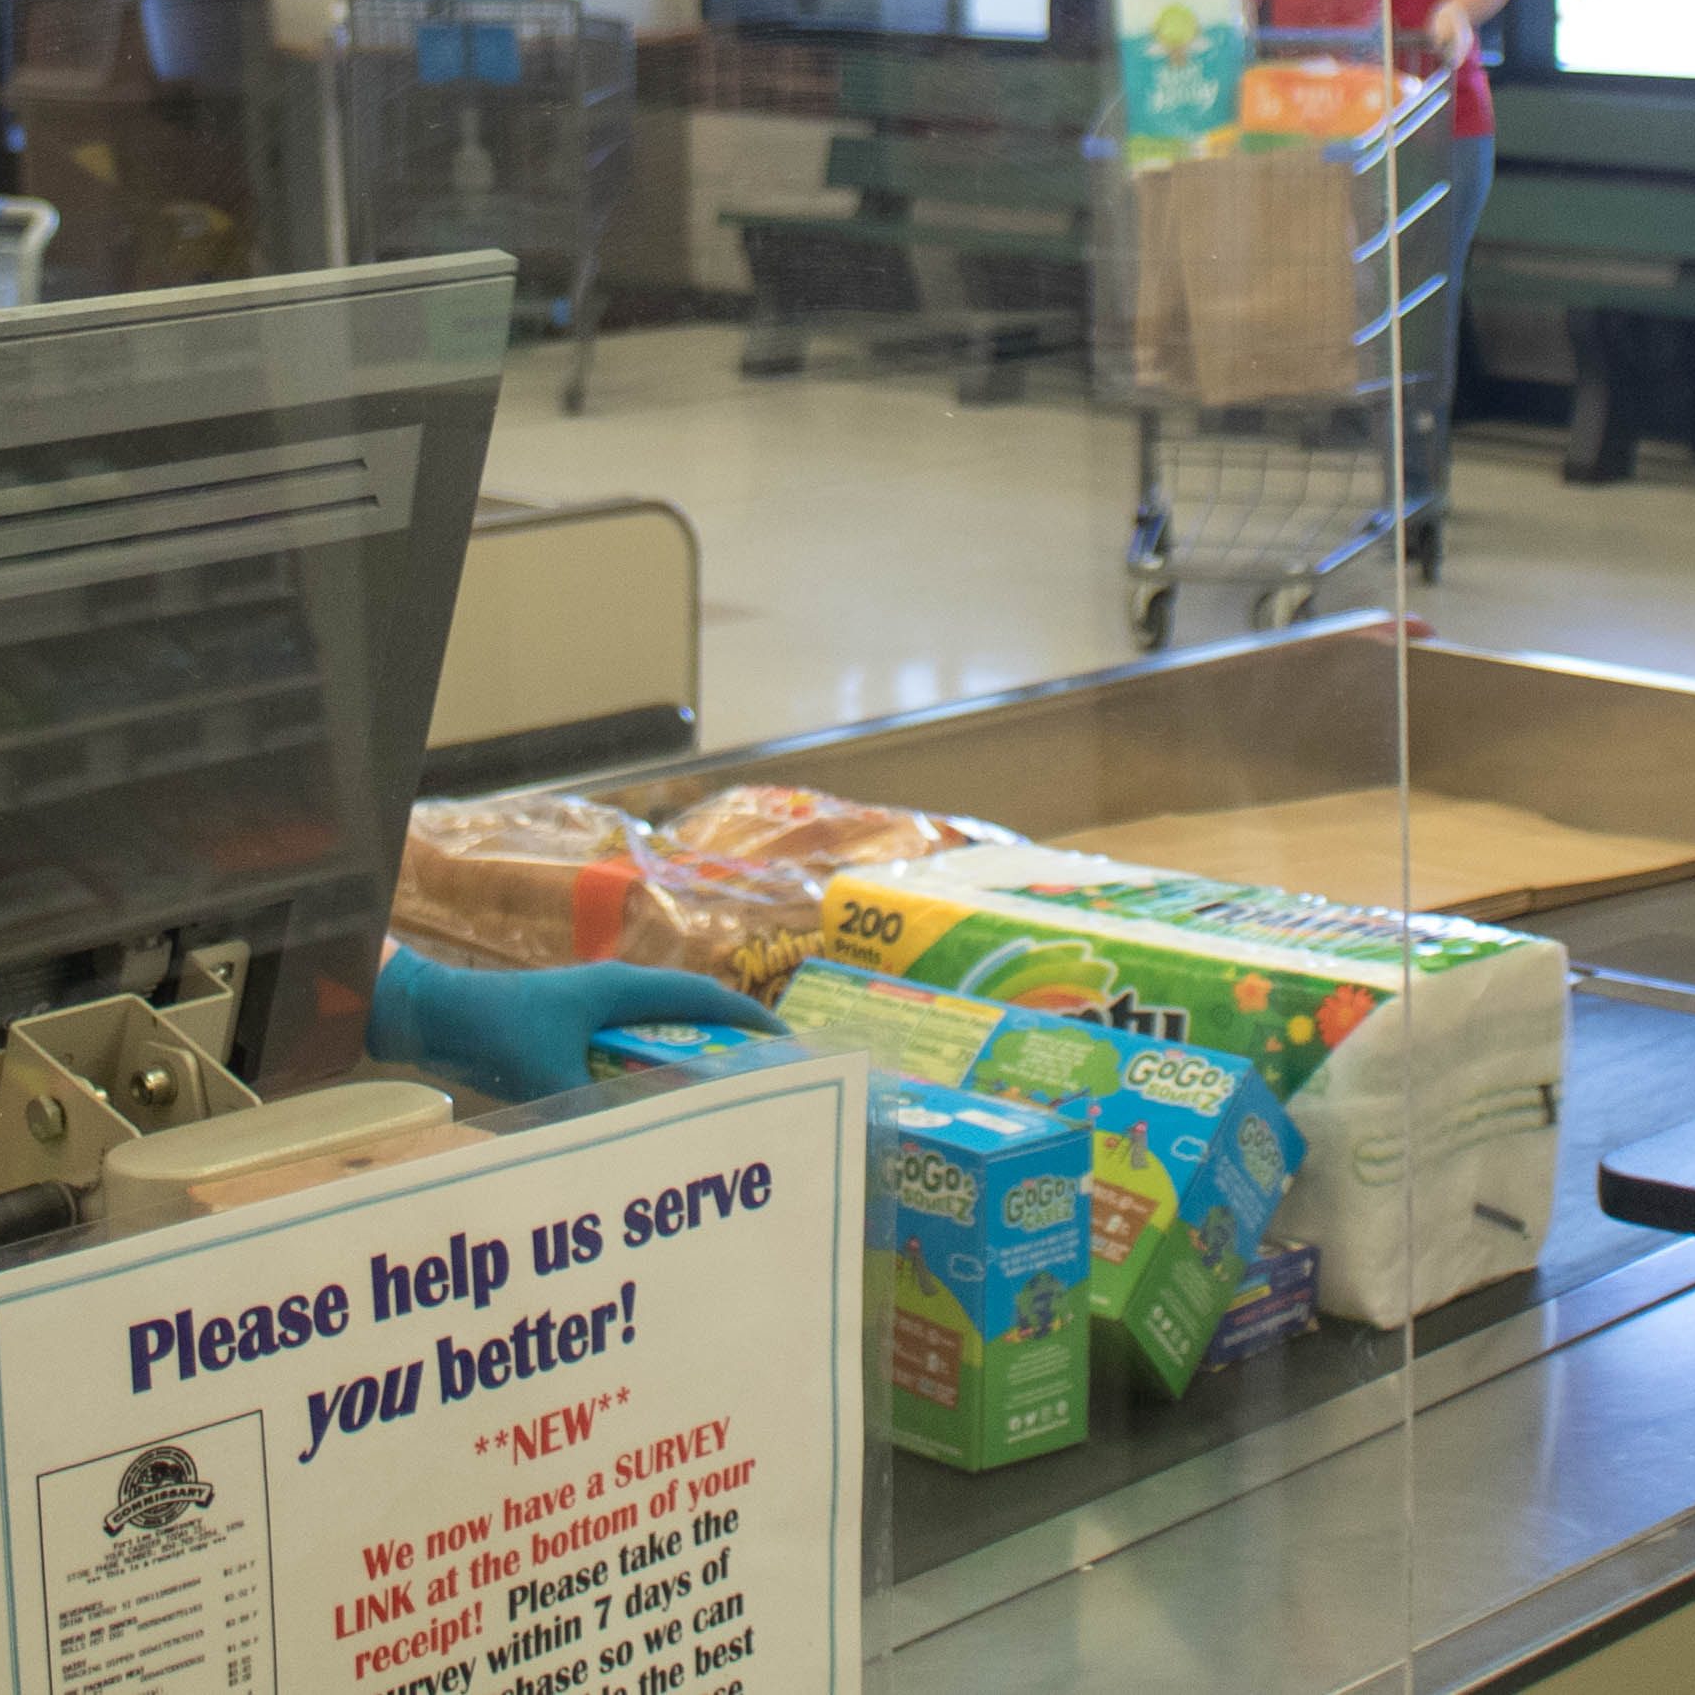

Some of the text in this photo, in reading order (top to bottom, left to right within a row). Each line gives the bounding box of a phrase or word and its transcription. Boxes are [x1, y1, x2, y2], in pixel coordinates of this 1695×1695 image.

[837, 900, 904, 945] 200
[128, 1160, 773, 1395] Please help us serve
[298, 1282, 637, 1464] you better!
[112, 1485, 206, 1524] COMMISSARY
[333, 1457, 757, 1641] LINK at the bottom of your
[362, 1416, 731, 1582] We now have a SURVEY
[353, 1507, 740, 1681] receipt! Please take the
[486, 1615, 583, 1676] within
[593, 1596, 613, 1632] 7
[624, 1565, 693, 1620] days
[700, 1546, 731, 1587] of
[598, 1638, 634, 1676] so
[643, 1617, 683, 1656] we
[692, 1591, 745, 1635] can
[693, 1625, 756, 1678] best
